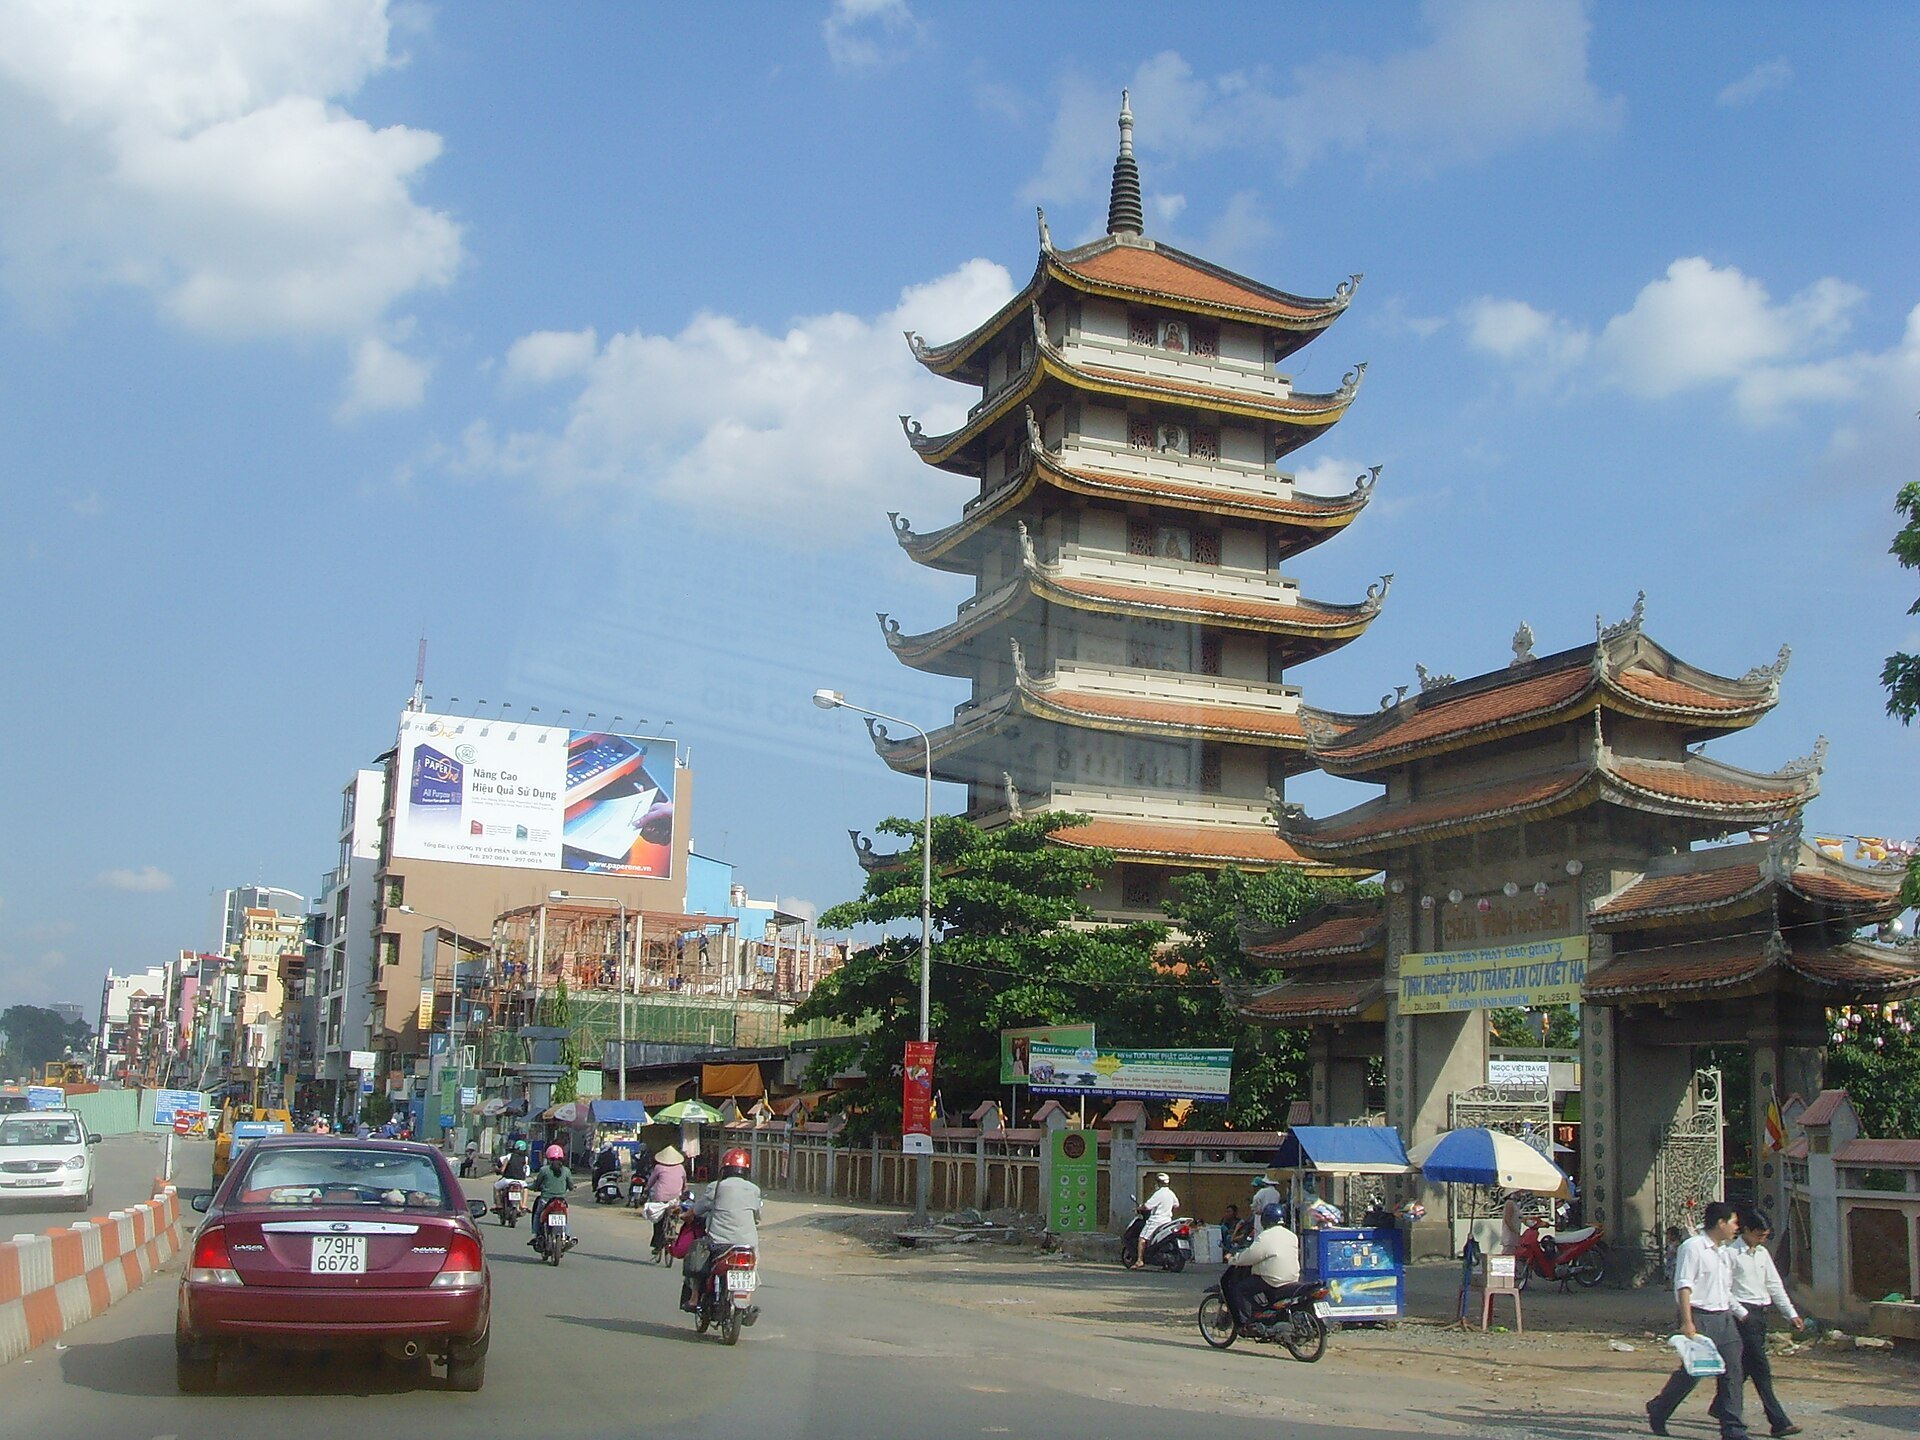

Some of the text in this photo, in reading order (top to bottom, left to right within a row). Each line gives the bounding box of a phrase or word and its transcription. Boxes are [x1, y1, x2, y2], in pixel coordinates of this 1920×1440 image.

[424, 757, 449, 774] PAPER
[473, 768, 518, 781] Nâng Cao
[472, 782, 494, 795] Hiệu
[496, 784, 515, 796] Quả
[517, 786, 531, 797] Sử
[532, 788, 557, 801] Dụng
[588, 861, 652, 872] www.paperone.vn
[1490, 1064, 1547, 1073] NGỌC VIỆT TRAVEL
[323, 1237, 355, 1253] 79H
[317, 1254, 359, 1272] 6678
